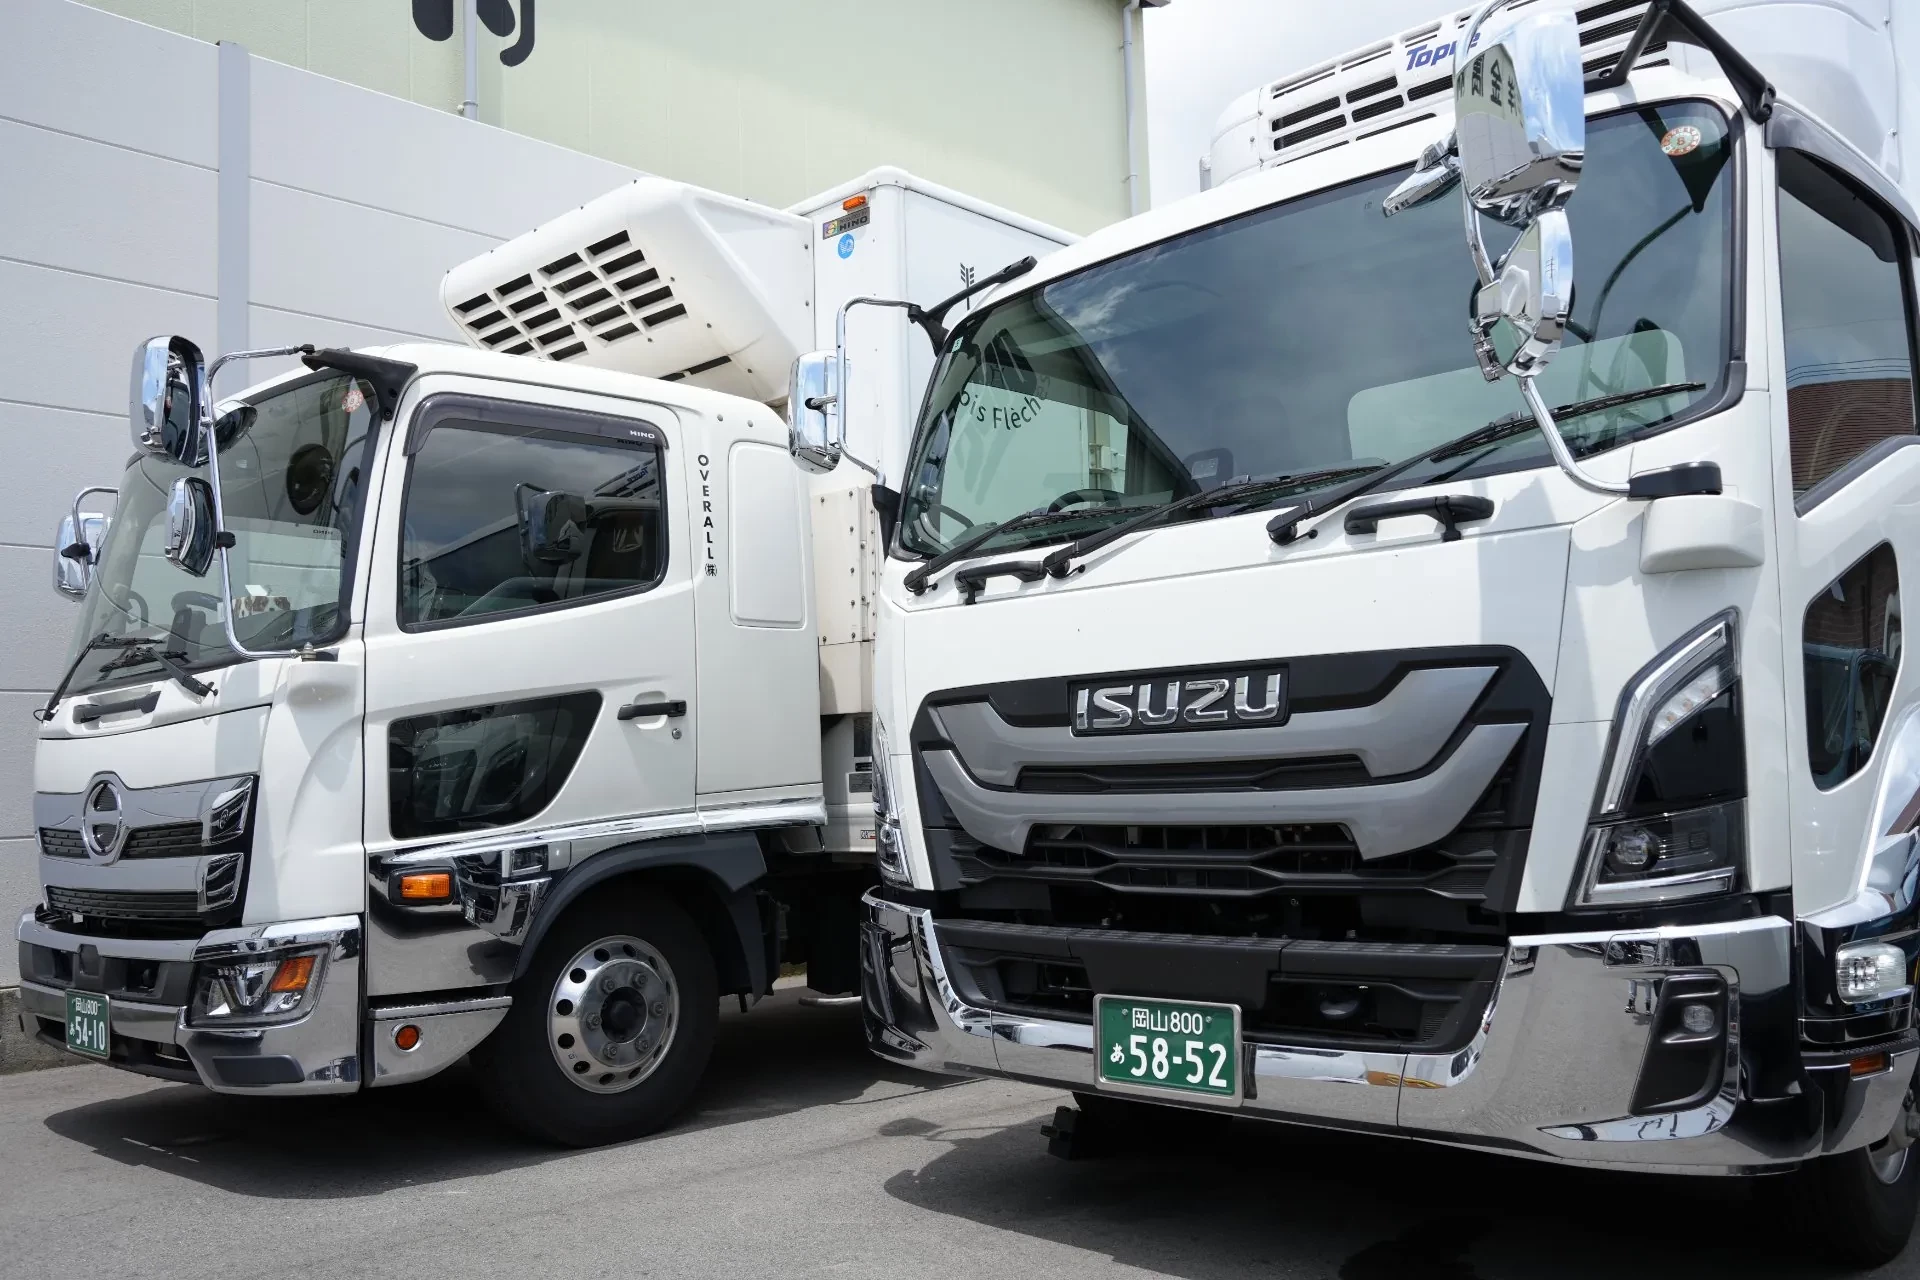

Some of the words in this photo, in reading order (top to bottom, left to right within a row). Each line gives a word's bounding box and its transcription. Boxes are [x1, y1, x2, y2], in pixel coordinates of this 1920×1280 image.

[839, 215, 868, 231] HINO
[630, 430, 656, 439] HINO
[1076, 673, 1281, 729] ISUZU
[1132, 1007, 1203, 1035] 岡山800
[1130, 1035, 1227, 1088] 58-52
